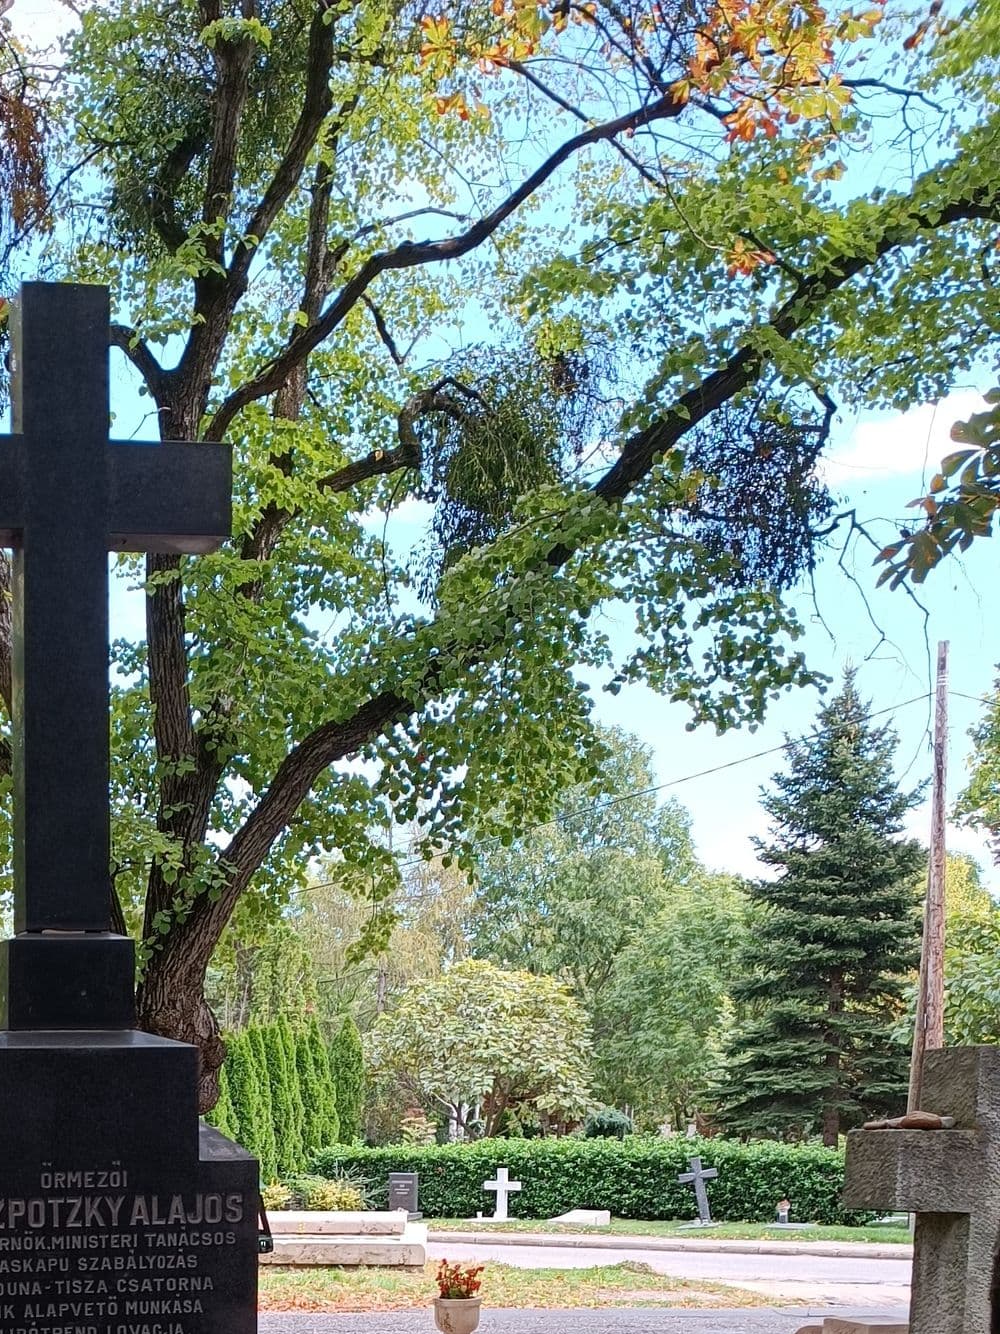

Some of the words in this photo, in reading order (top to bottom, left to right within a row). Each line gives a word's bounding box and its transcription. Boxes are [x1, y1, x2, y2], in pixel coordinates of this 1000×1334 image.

[130, 1193, 244, 1226] ALAJOS
[145, 1227, 236, 1247] TANÁCSOS
[78, 1249, 198, 1271] SZABÁLYOZÁS
[117, 1276, 214, 1293] CSATORNA
[126, 1293, 204, 1315] MUNKÁSA
